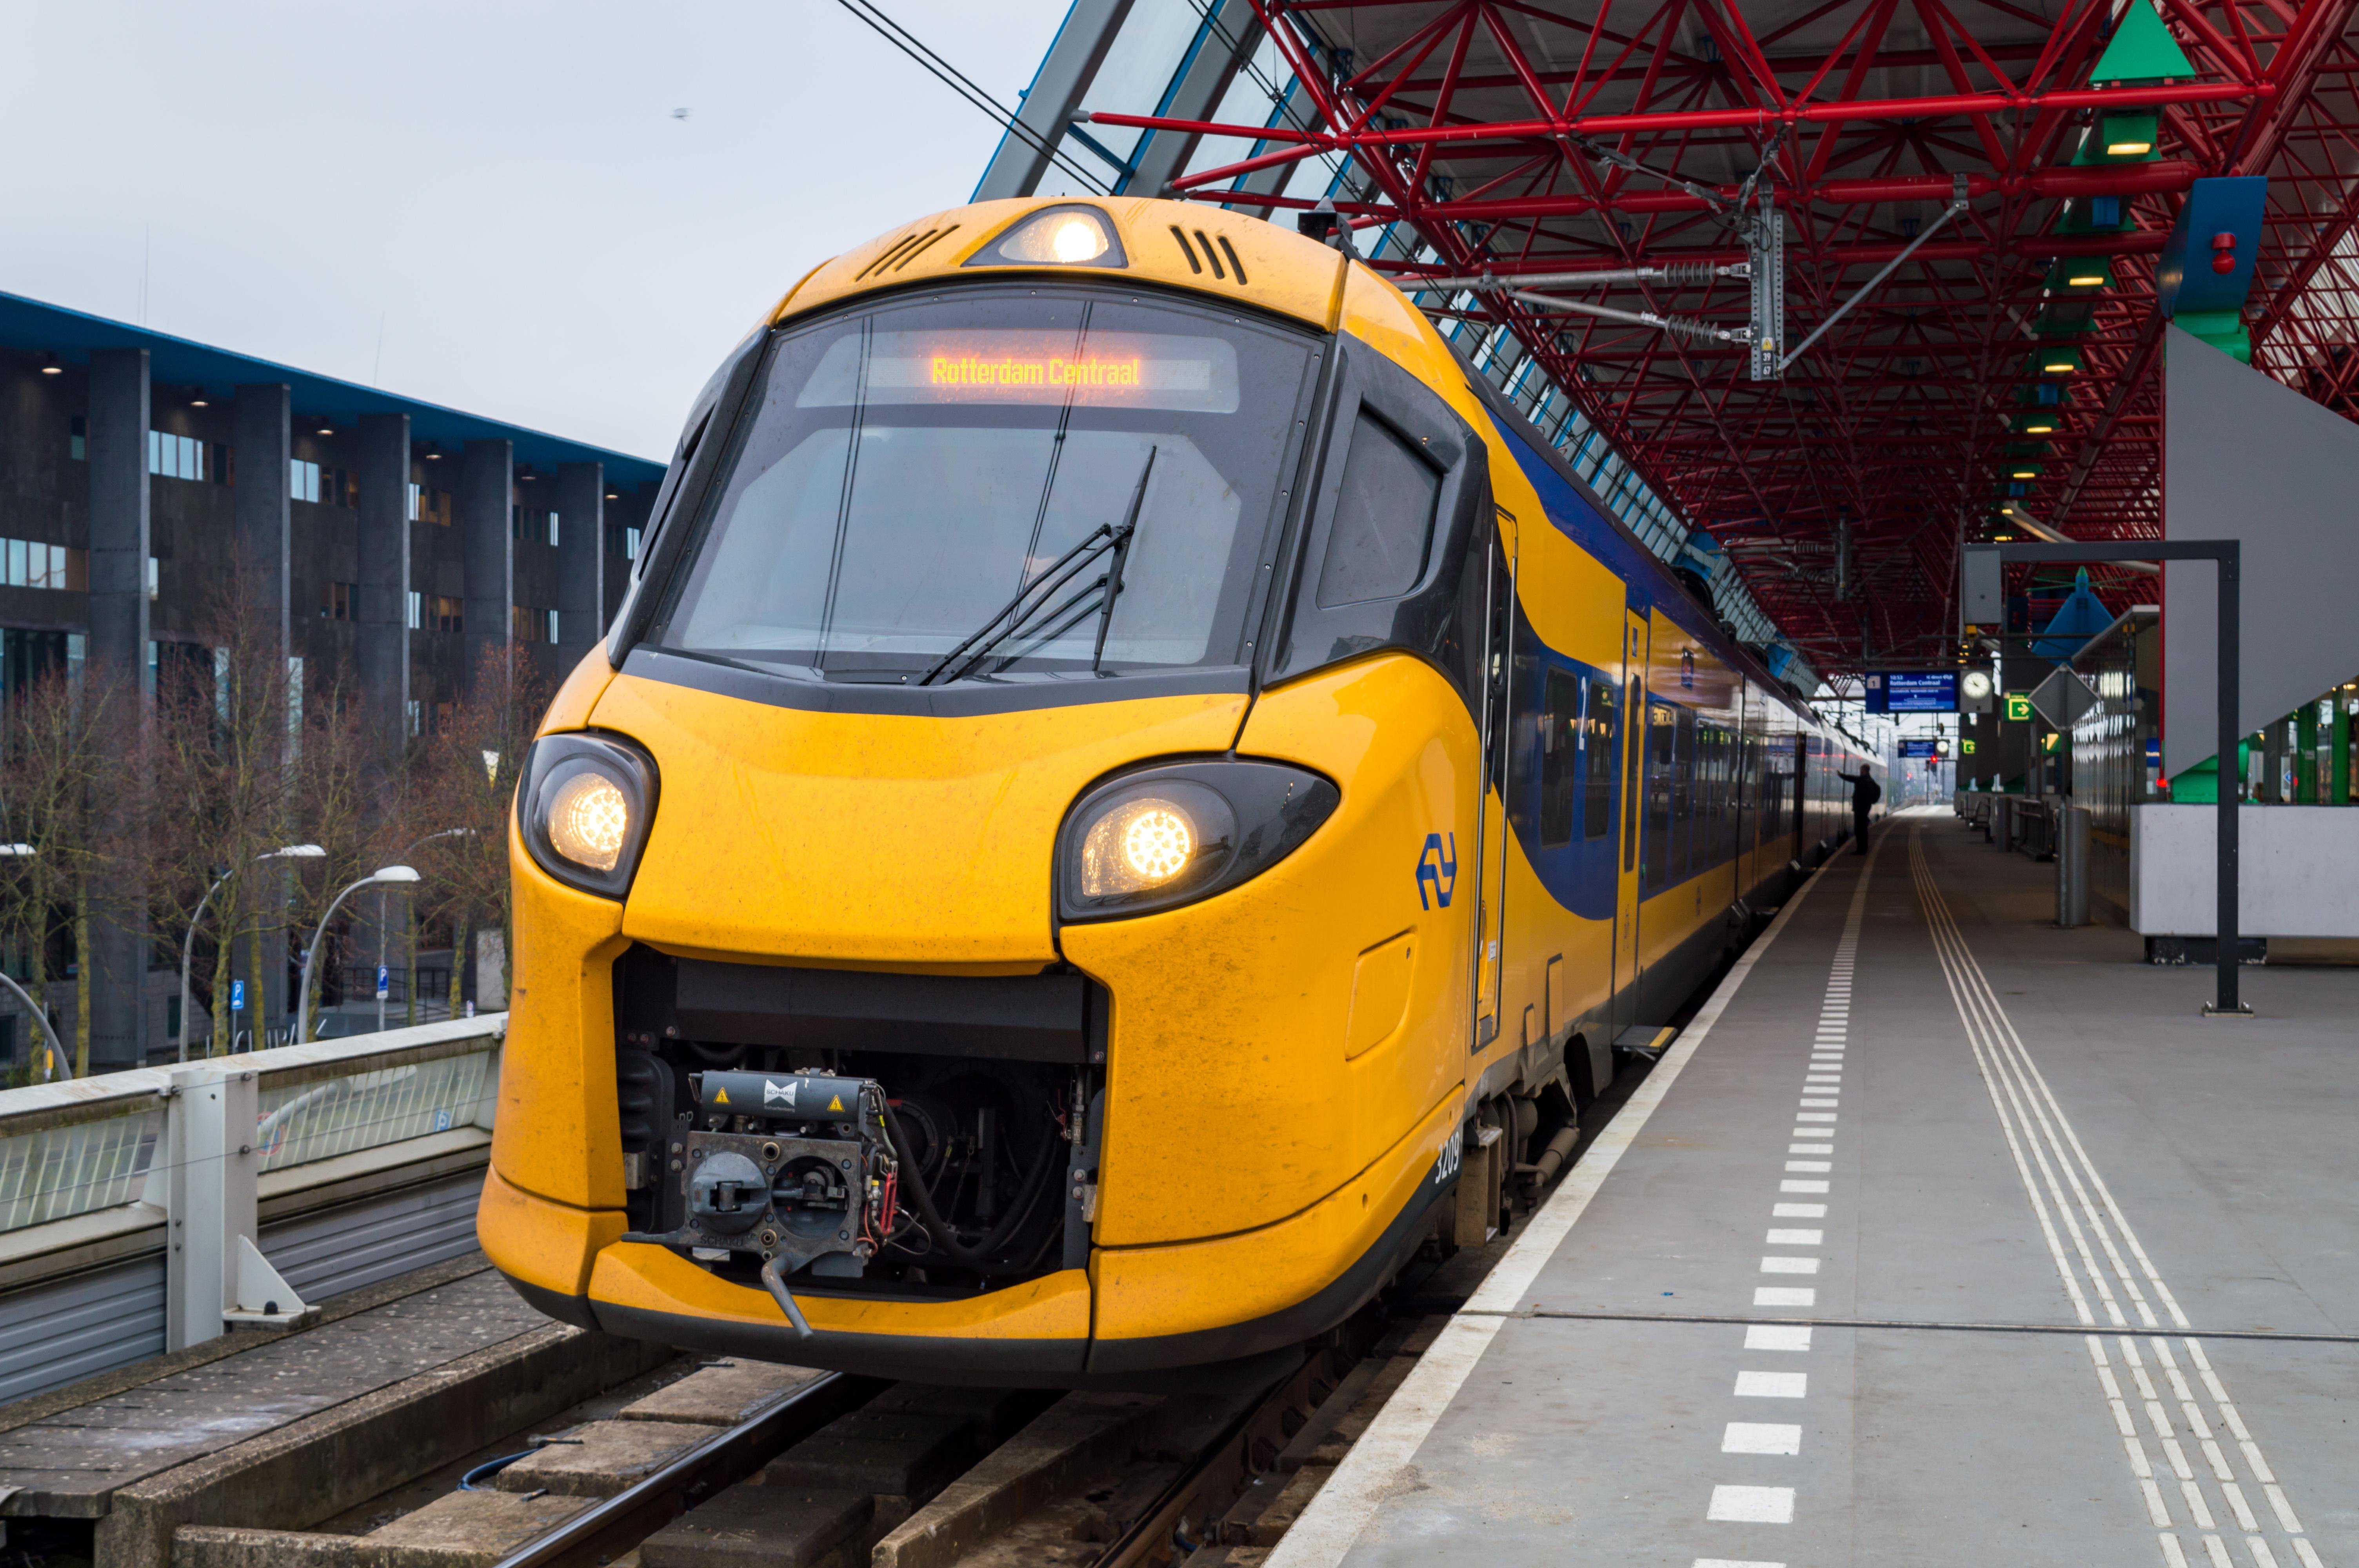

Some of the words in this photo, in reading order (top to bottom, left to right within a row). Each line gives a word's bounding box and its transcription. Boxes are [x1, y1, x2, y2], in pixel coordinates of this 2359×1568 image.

[1763, 353, 1771, 361] 39
[932, 358, 1043, 385] Rotterdam
[1049, 358, 1139, 385] Centraal
[1763, 366, 1771, 375] 67
[1579, 676, 1586, 750] 2
[381, 968, 387, 981] P
[235, 984, 241, 997] P
[1435, 1131, 1459, 1184] 3209
